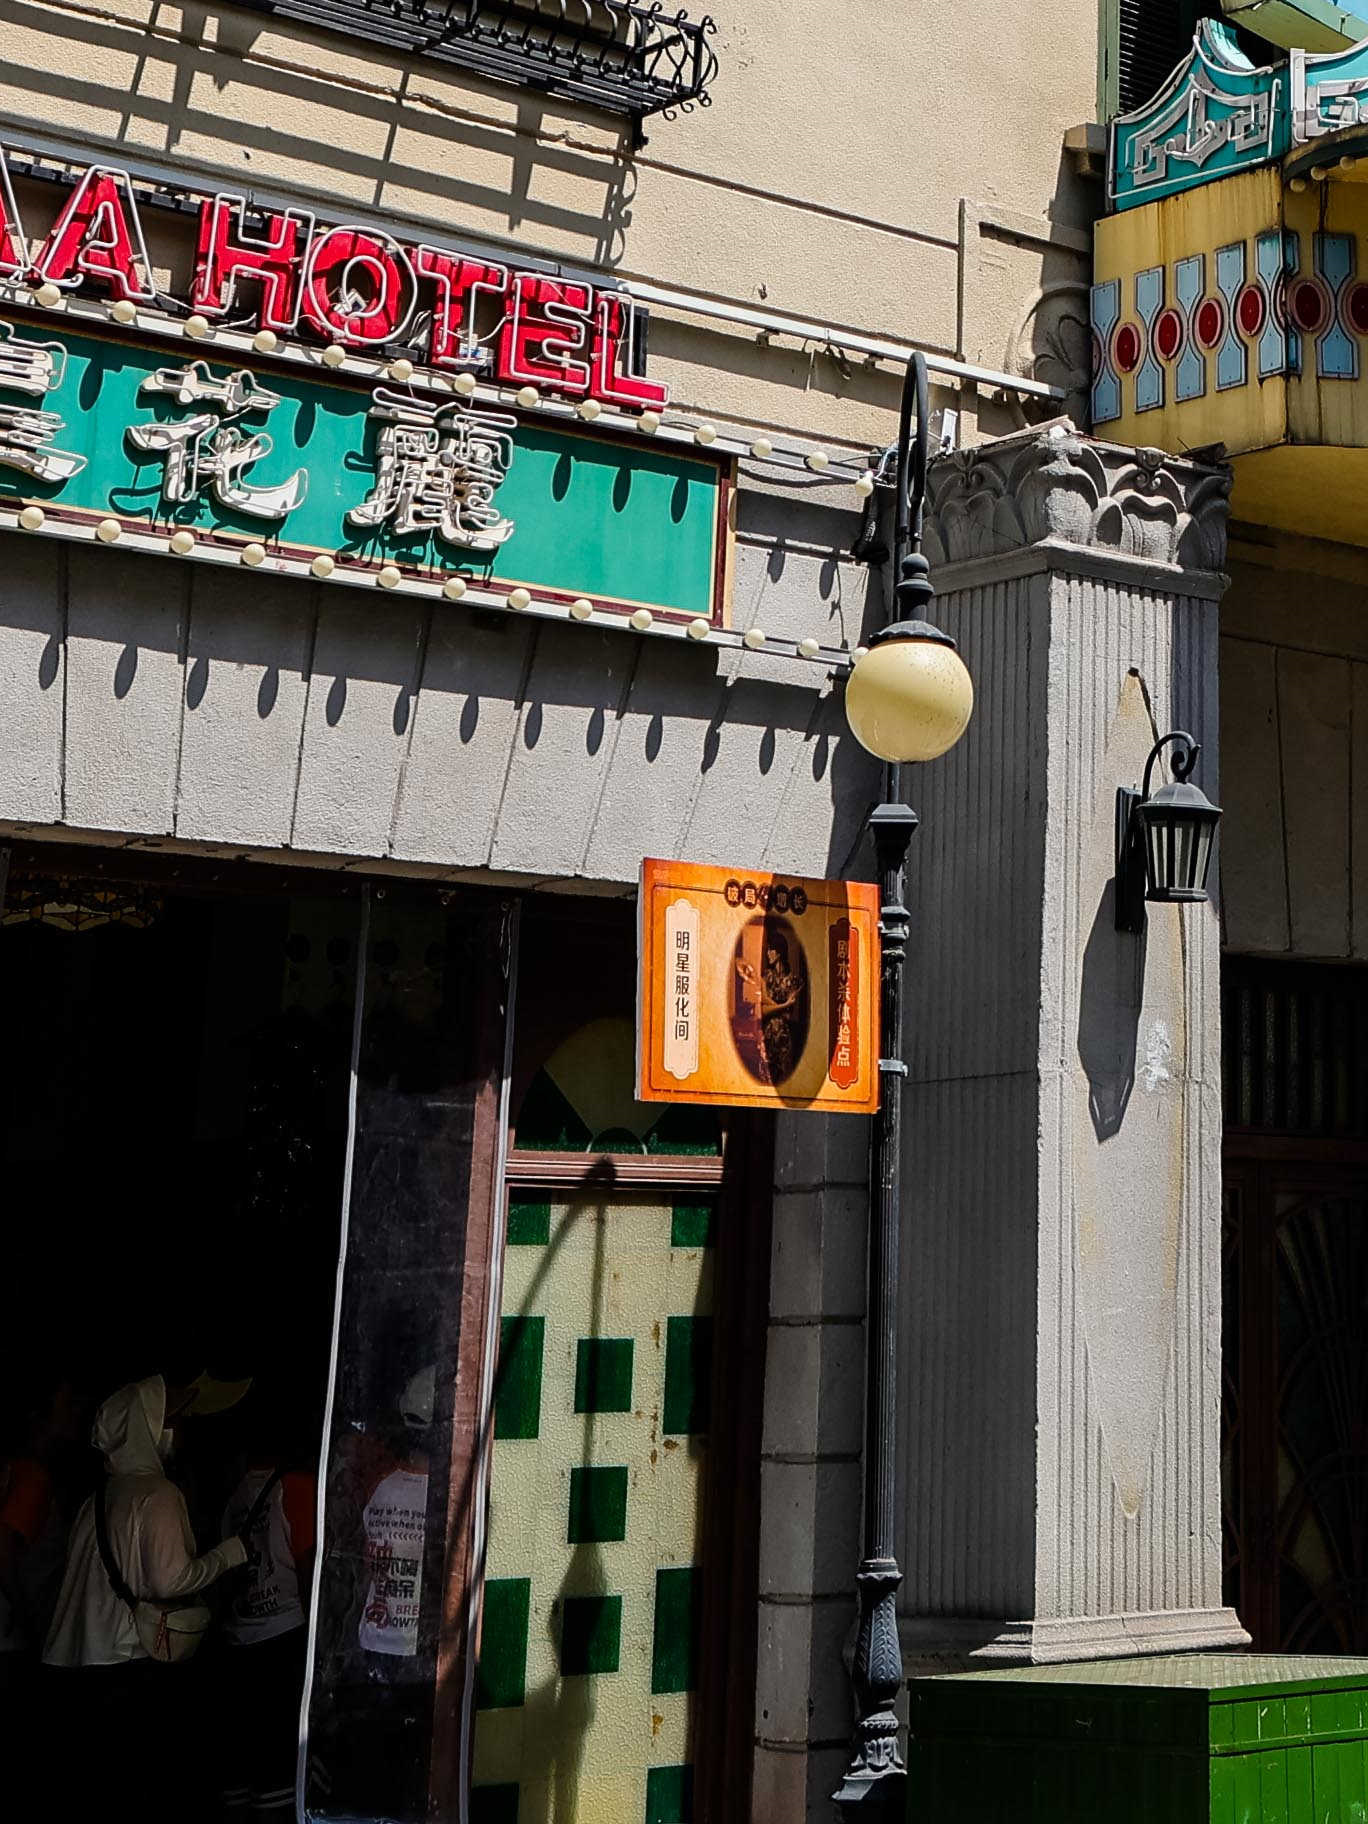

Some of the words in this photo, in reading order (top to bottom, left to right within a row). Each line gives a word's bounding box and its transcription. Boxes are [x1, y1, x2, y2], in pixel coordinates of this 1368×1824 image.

[193, 192, 670, 414] HOTEL
[674, 930, 691, 1042] 明星服化间
